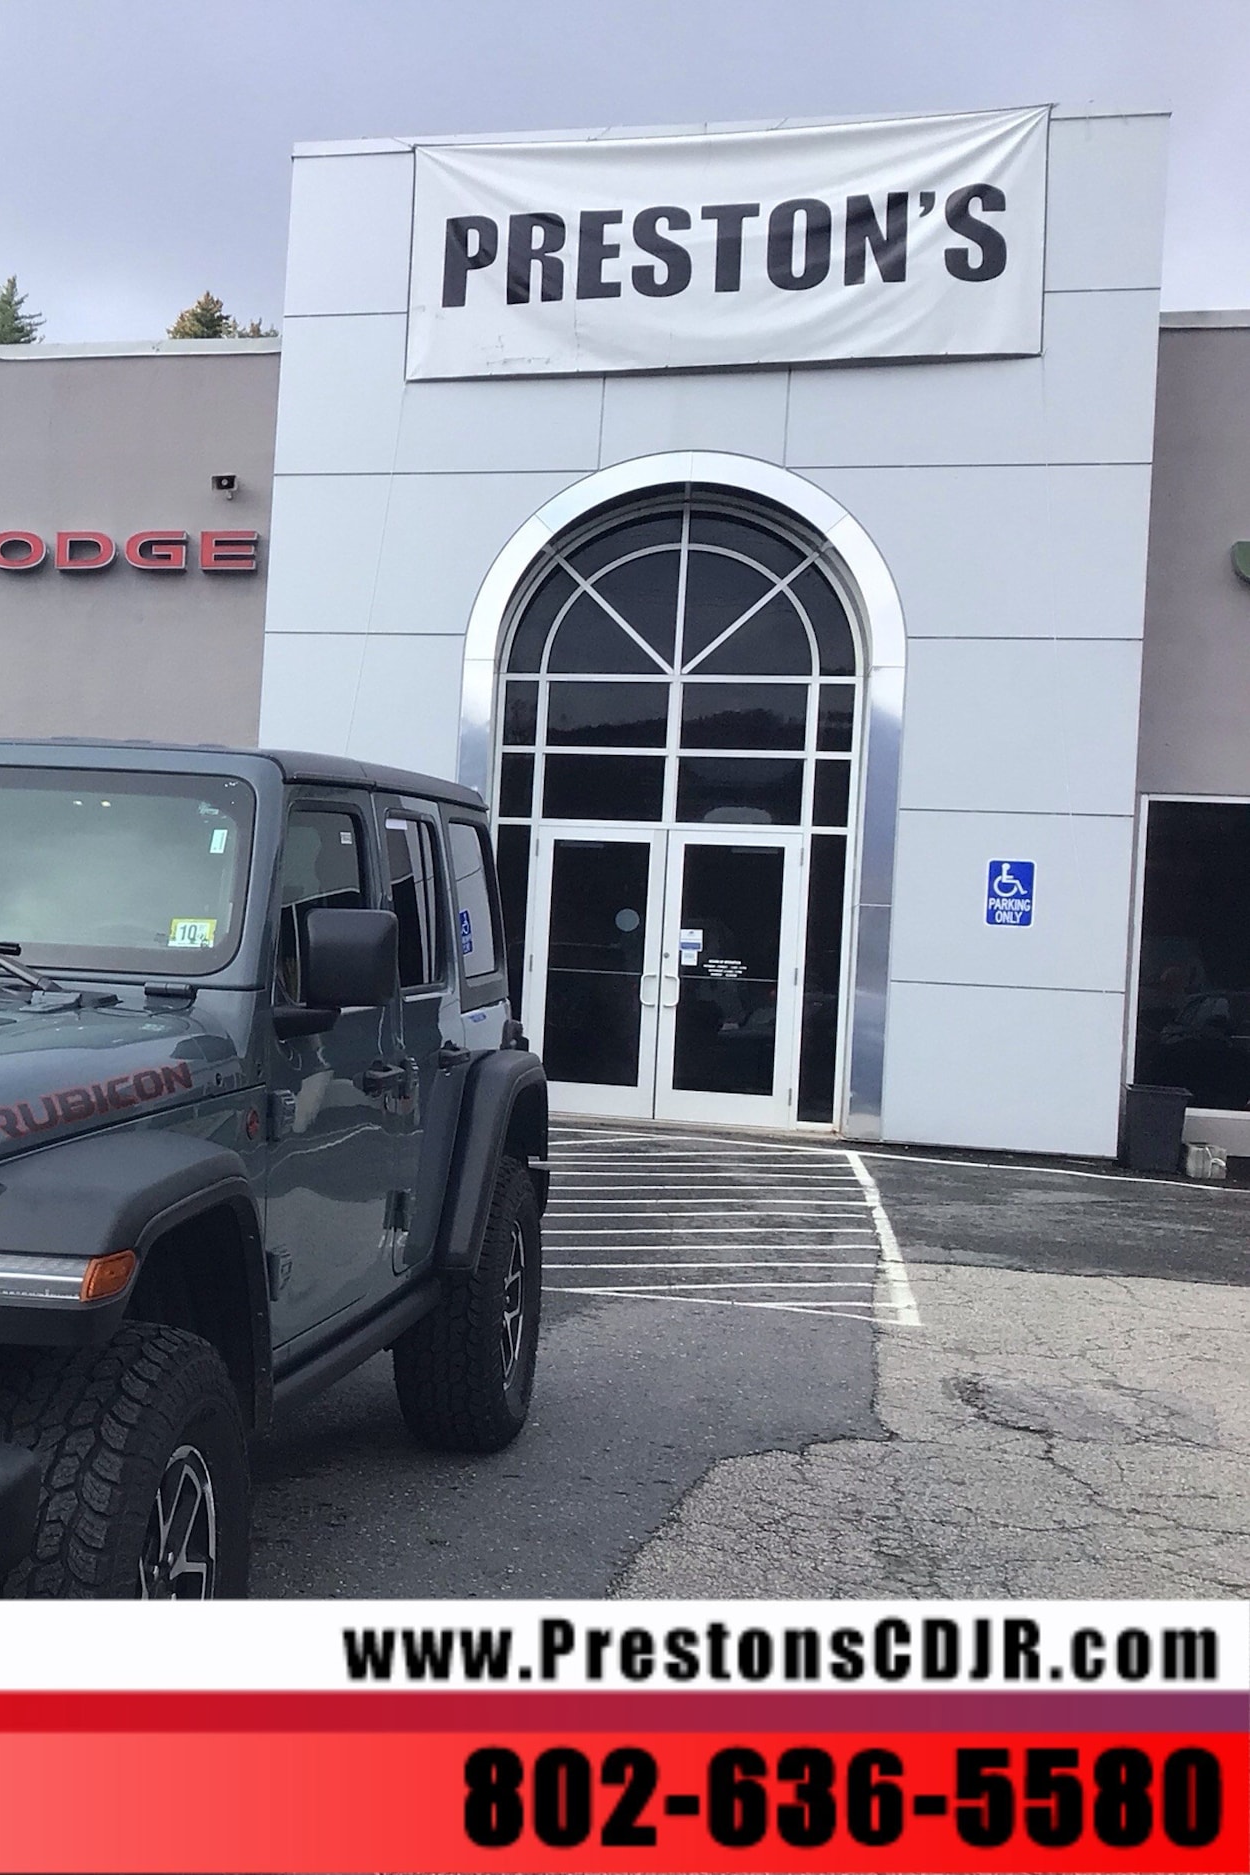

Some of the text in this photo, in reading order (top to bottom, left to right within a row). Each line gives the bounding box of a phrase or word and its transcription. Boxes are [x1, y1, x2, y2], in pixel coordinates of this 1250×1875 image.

[442, 183, 1007, 308] PRESTON'S
[988, 897, 1031, 912] PARKING
[995, 910, 1023, 924] ONLY
